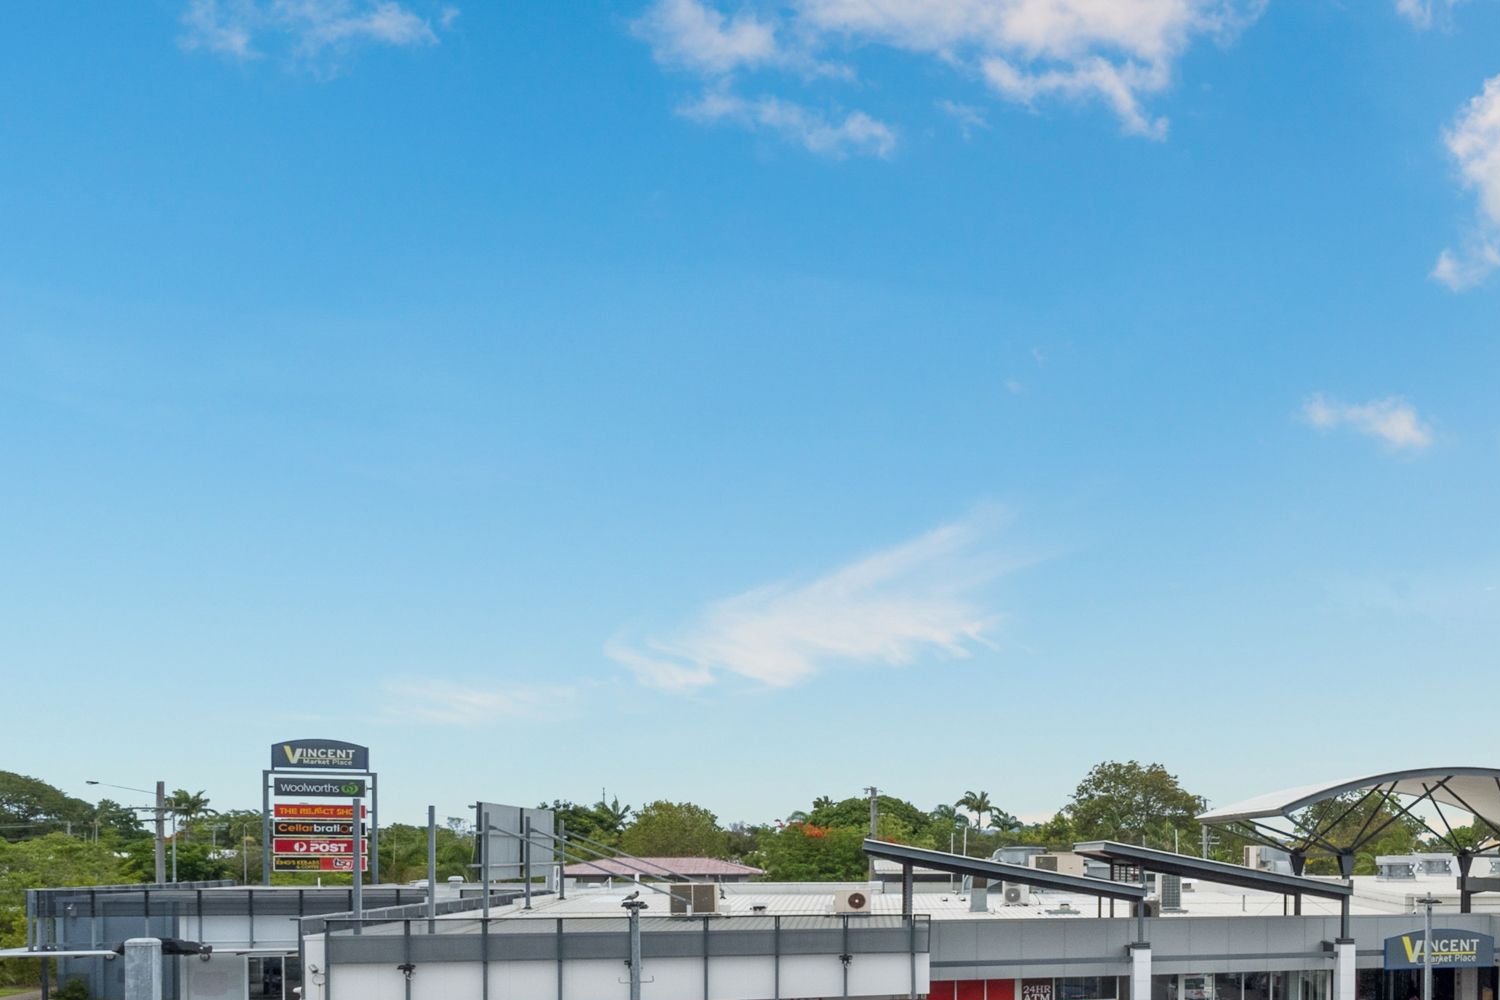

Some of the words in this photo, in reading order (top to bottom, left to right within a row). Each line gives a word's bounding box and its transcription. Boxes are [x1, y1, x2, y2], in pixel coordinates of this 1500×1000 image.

[283, 745, 355, 764] VINCENT
[332, 758, 352, 766] Place
[280, 783, 340, 793] Woolworths
[279, 807, 298, 815] THE
[300, 807, 335, 815] REJECT
[336, 808, 354, 816] SHO
[310, 843, 347, 852] POST
[1402, 936, 1479, 963] VNCENT
[1454, 953, 1477, 962] Place
[1023, 985, 1051, 994] 24HR
